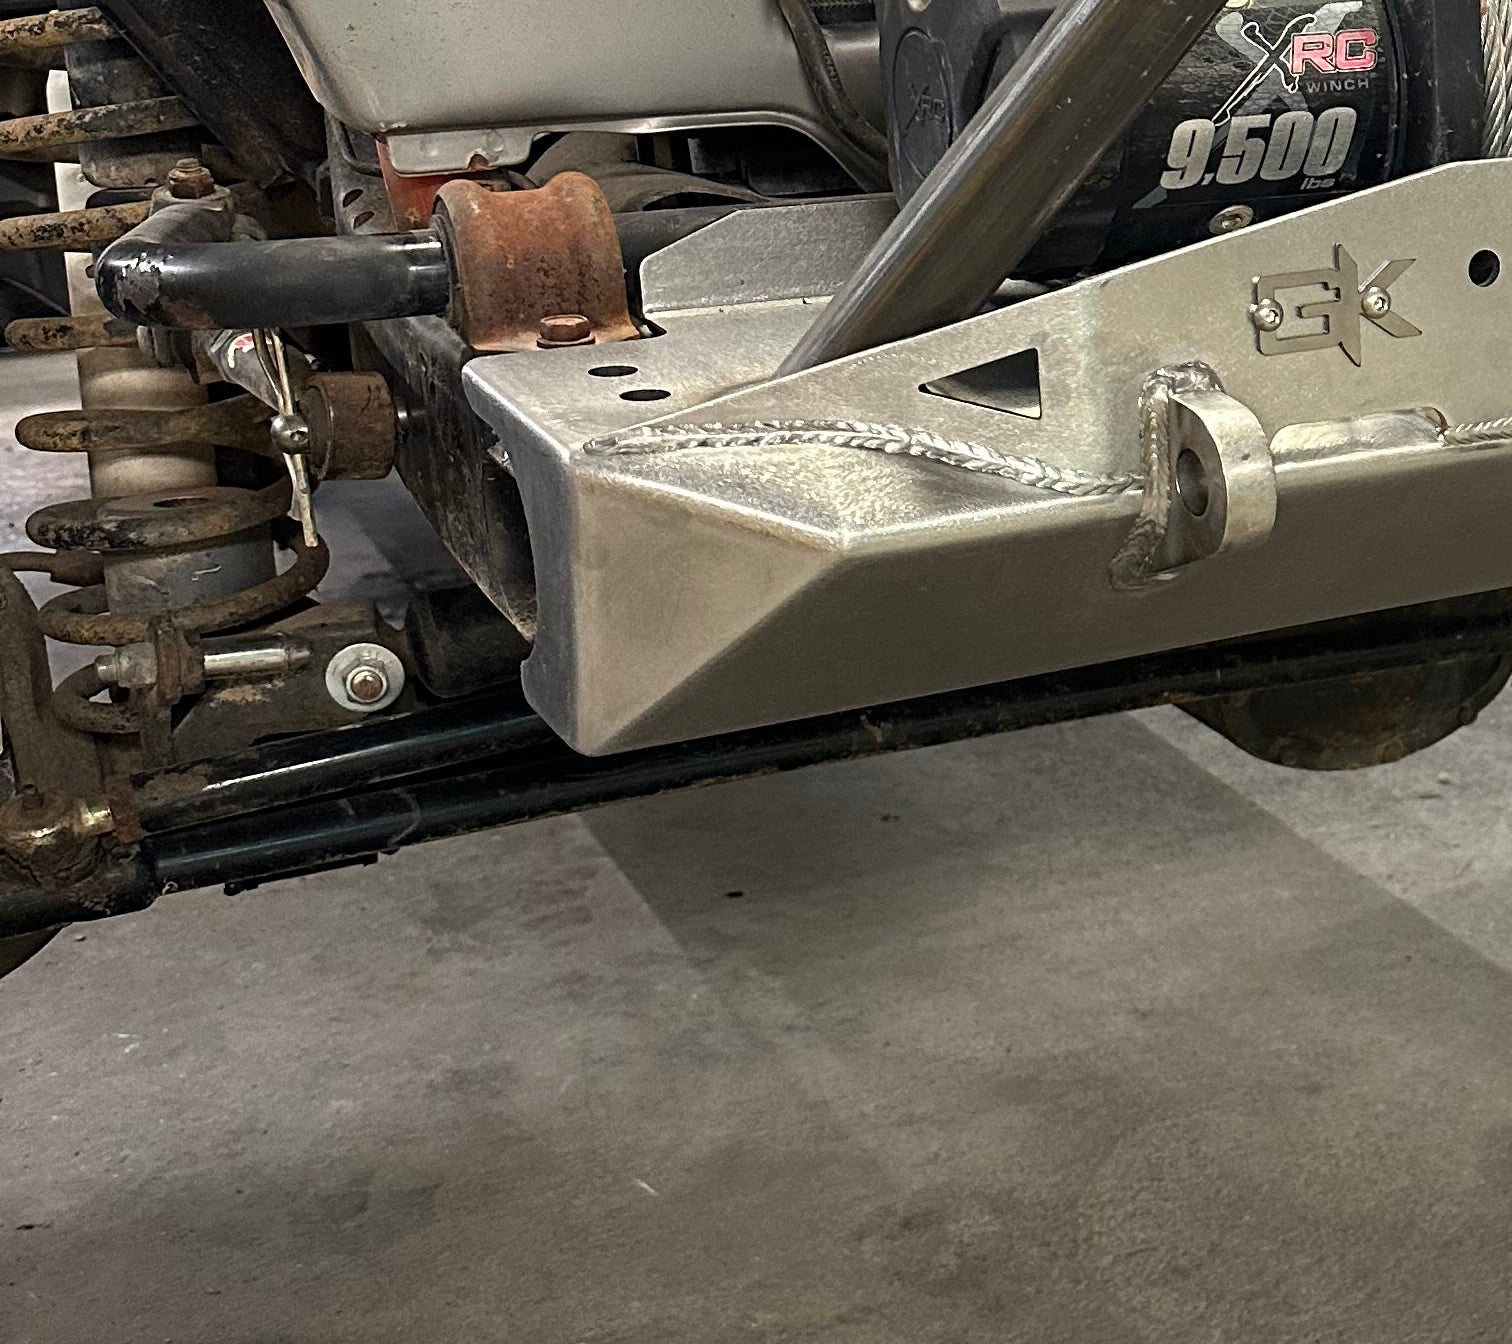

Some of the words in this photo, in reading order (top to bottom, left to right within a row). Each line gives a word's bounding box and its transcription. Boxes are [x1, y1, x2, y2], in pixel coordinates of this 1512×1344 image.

[1212, 13, 1378, 127] XRC
[1305, 77, 1369, 93] WINCH
[1160, 106, 1357, 190] 9,500
[1300, 176, 1336, 190] lbs
